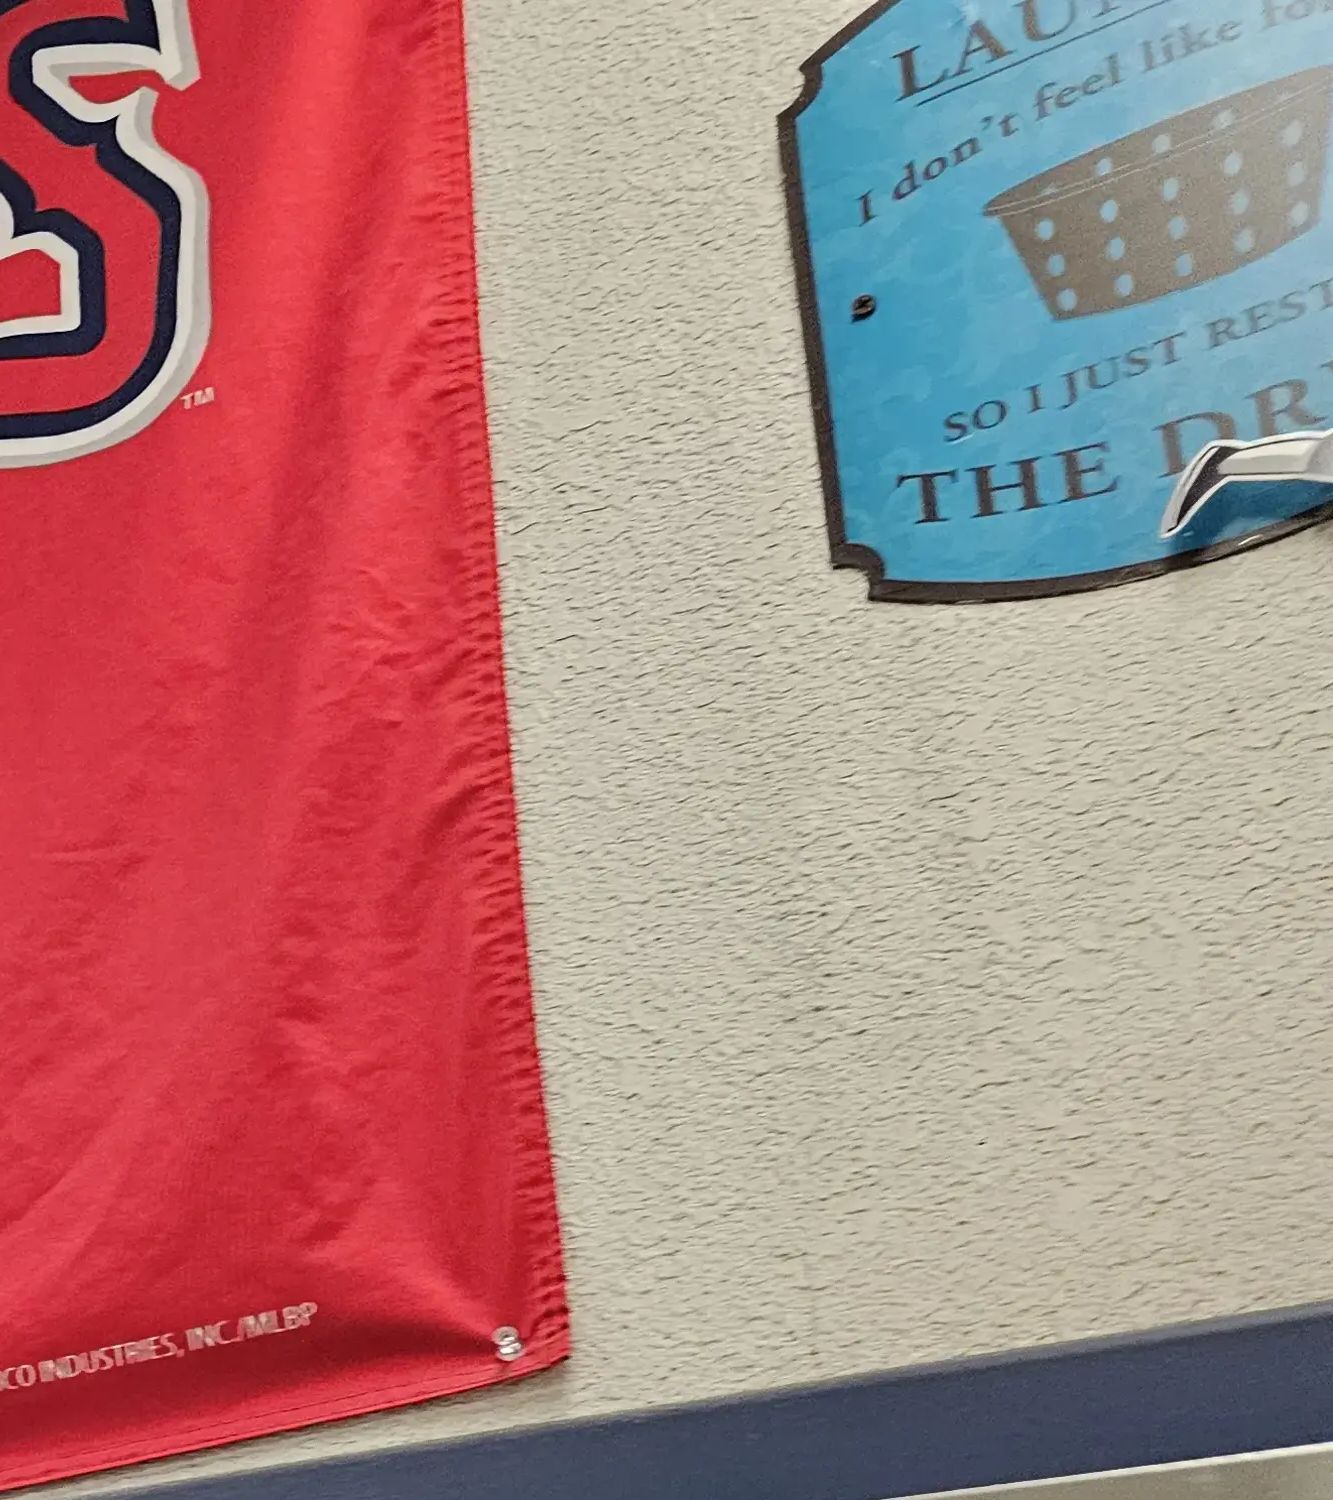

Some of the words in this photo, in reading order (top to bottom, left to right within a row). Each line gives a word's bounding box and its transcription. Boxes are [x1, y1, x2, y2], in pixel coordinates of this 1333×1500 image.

[889, 0, 1121, 102] LAU
[855, 188, 878, 228] I
[892, 112, 1023, 201] don't
[1033, 51, 1126, 122] feel
[1139, 20, 1243, 73] like
[897, 441, 1121, 525] THE
[1151, 360, 1333, 478] DR
[942, 399, 1010, 443] SO
[1024, 383, 1046, 414] I
[1056, 330, 1187, 410] JUST
[39, 1332, 186, 1383] INDUSTRIES,
